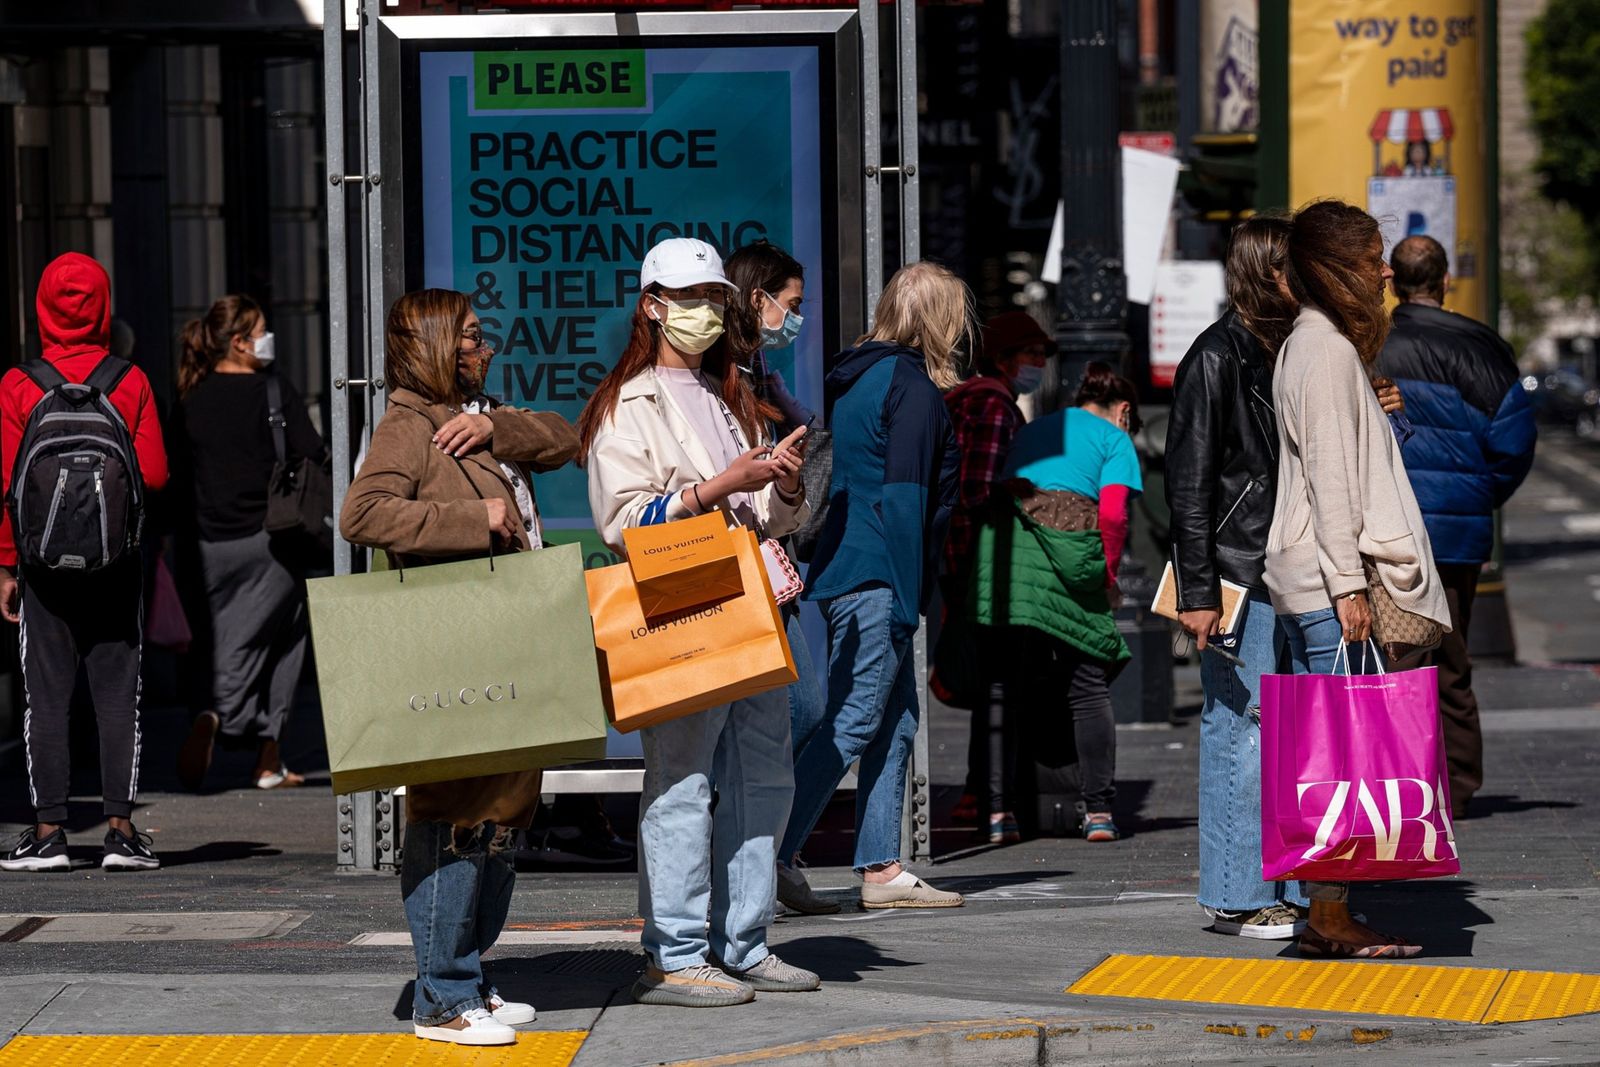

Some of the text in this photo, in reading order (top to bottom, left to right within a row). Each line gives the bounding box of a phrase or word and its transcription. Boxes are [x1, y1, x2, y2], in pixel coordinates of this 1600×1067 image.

[1335, 14, 1476, 47] way to get
[488, 61, 632, 95] PLEASE
[1388, 47, 1448, 87] paid
[470, 129, 717, 171] PRACTICE
[468, 177, 652, 218] SOCIAL
[471, 269, 642, 310] & HELP
[488, 361, 607, 402] IVES
[643, 533, 714, 556] LOUIS VUITTON
[630, 604, 724, 640] LOUIS VUITTON
[409, 681, 516, 712] GUCCI
[1296, 774, 1459, 862] ZARA
